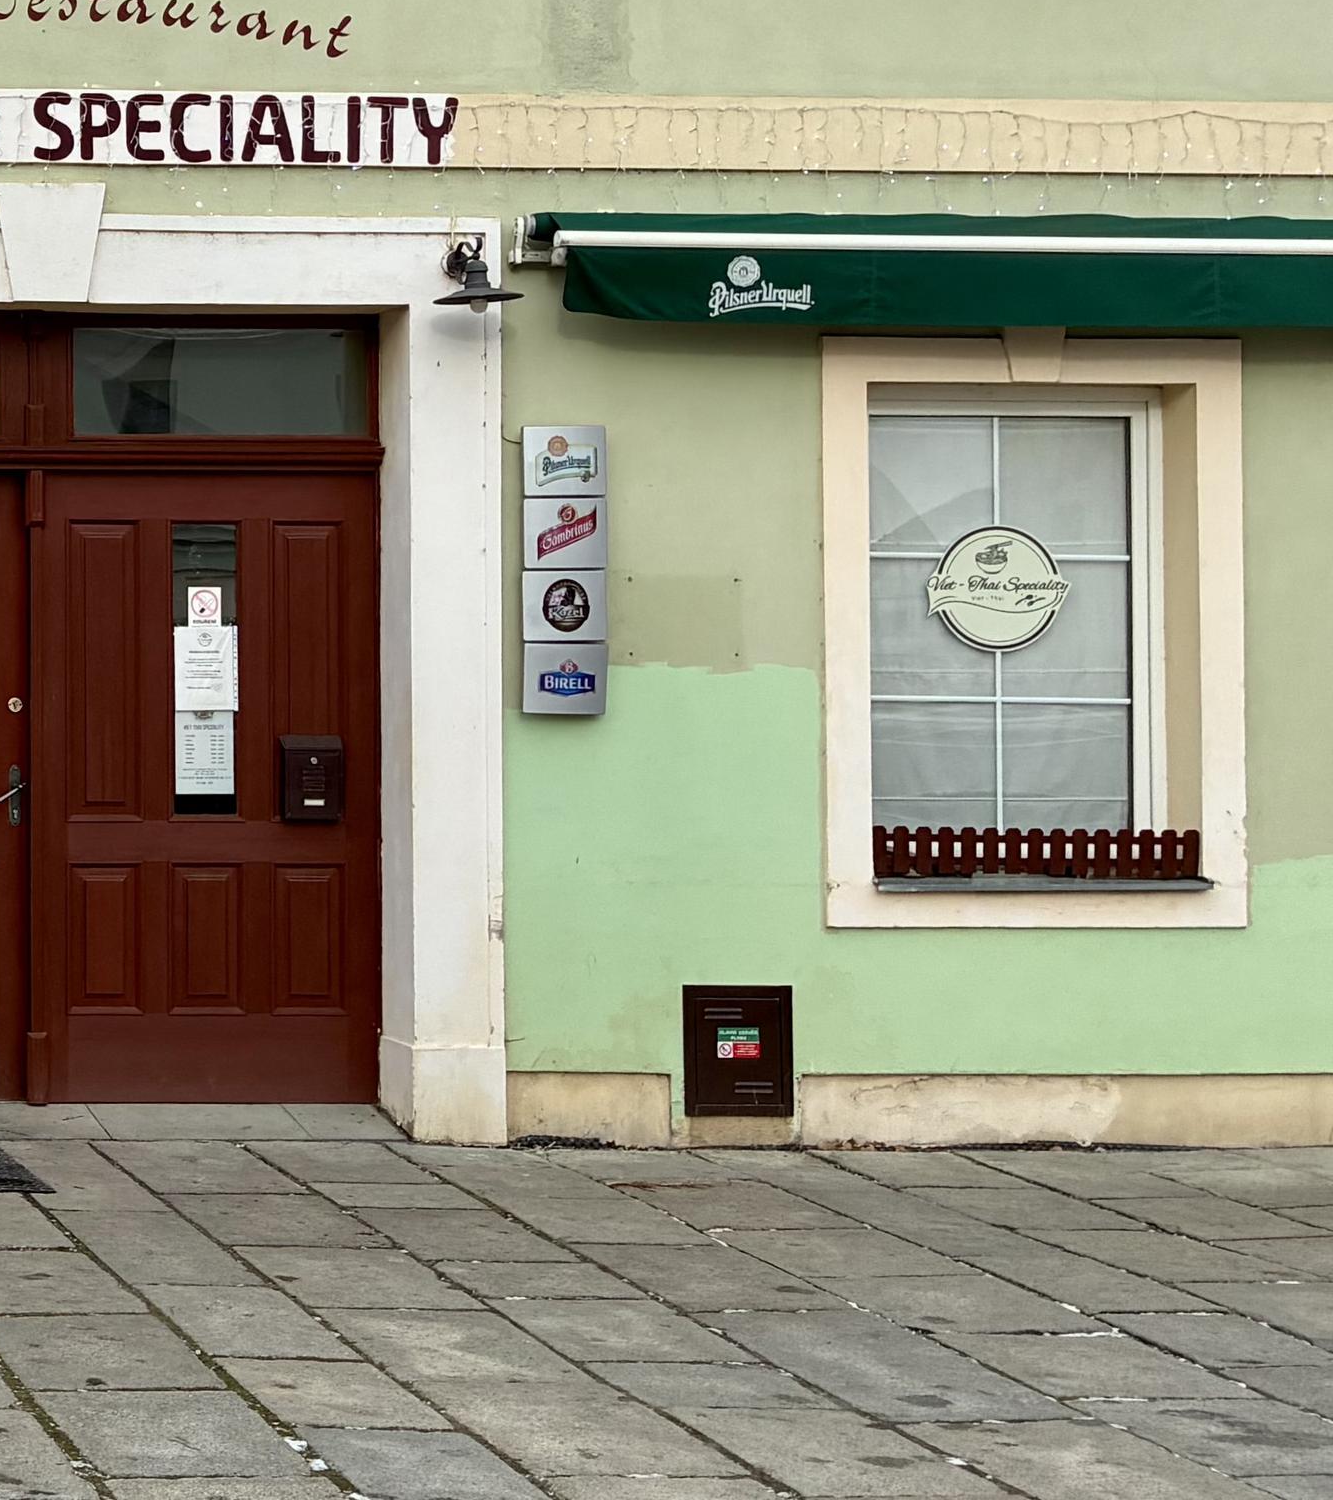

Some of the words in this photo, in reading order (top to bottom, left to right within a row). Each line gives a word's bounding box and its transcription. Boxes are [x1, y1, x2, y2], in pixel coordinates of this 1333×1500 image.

[33, 92, 460, 166] SPECIALITY
[708, 281, 763, 317] Pilsner
[541, 519, 594, 550] Gambrinus
[927, 575, 957, 592] Viet
[968, 575, 1001, 592] Thai
[1003, 576, 1070, 594] Speciality
[544, 675, 592, 690] BIRELL
